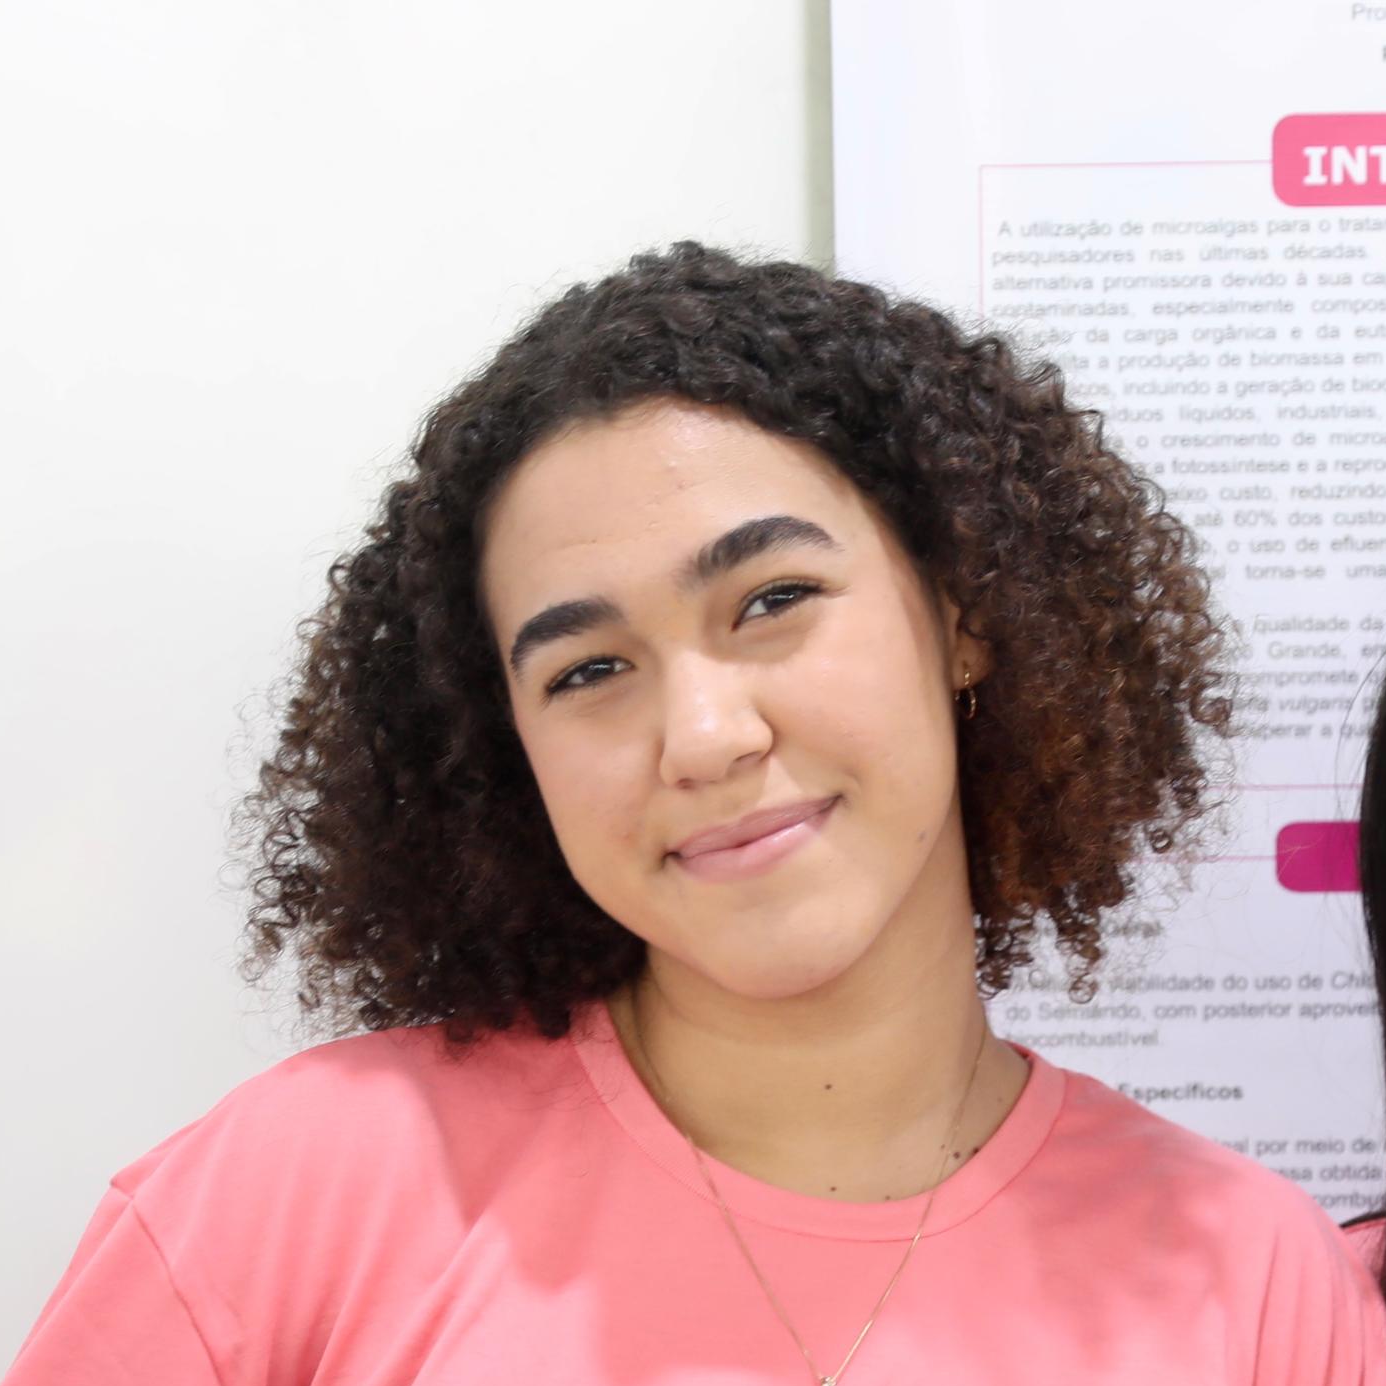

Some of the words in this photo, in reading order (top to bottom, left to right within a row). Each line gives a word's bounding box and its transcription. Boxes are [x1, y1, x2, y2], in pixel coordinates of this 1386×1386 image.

[1221, 972, 1248, 990] do
[1255, 976, 1291, 990] uso
[1297, 971, 1324, 990] de
[1255, 1140, 1288, 1158] por
[1295, 1135, 1344, 1154] meio
[1350, 1135, 1377, 1153] de
[1320, 1162, 1382, 1180] obtida
